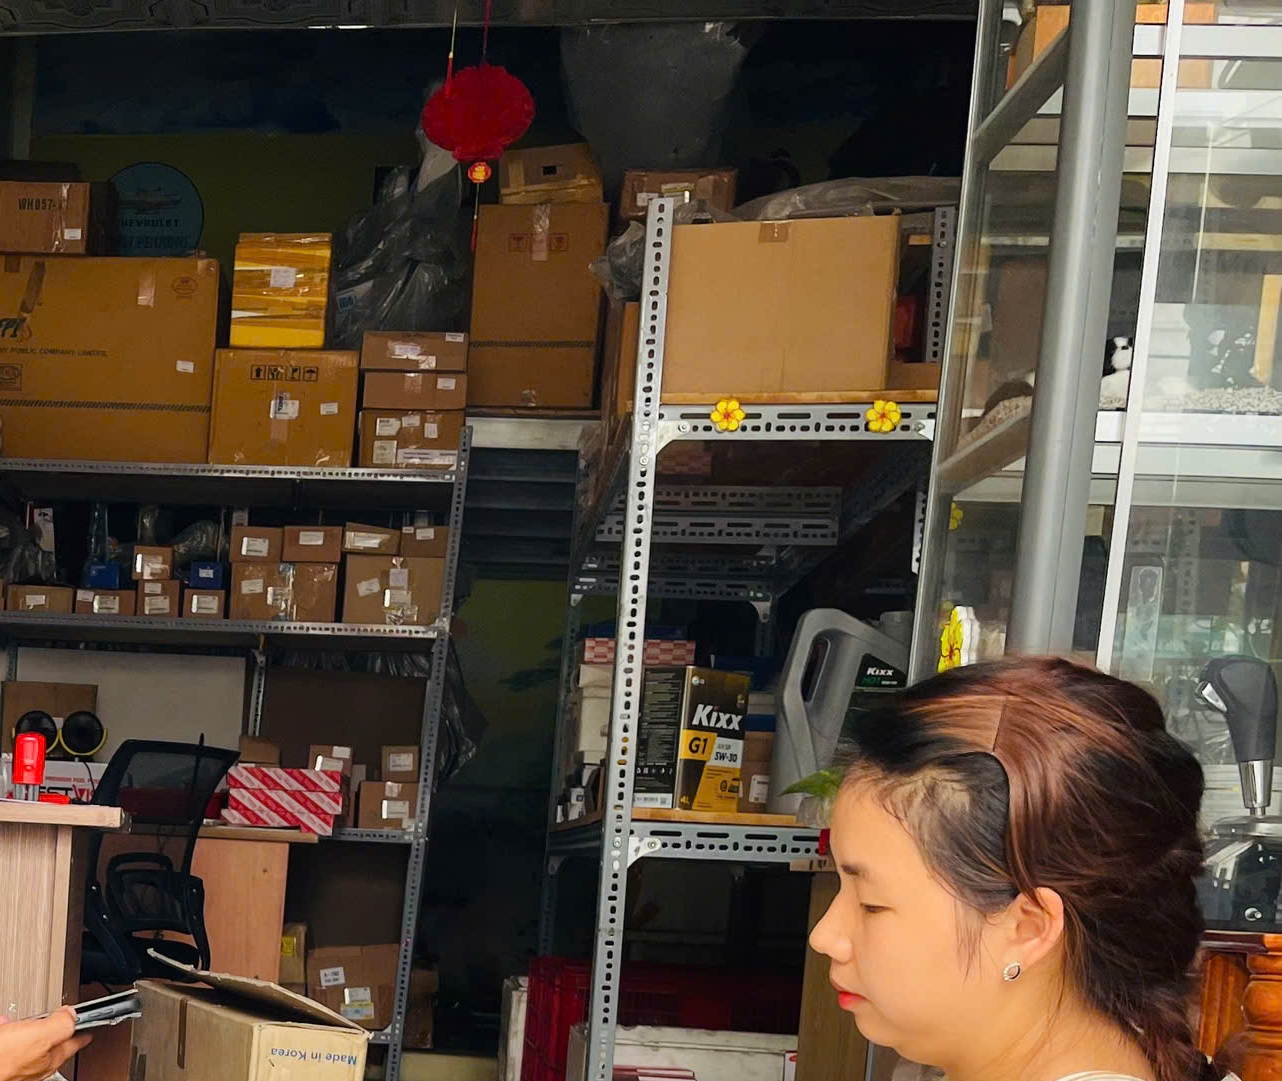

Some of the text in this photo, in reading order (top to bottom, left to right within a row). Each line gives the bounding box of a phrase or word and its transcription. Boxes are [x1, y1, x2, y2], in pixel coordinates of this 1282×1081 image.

[867, 666, 894, 676] Kixx
[692, 703, 743, 731] Kixx
[688, 736, 708, 755] G1
[714, 751, 738, 763] 5W-30
[271, 1047, 358, 1066] Made in Korea
